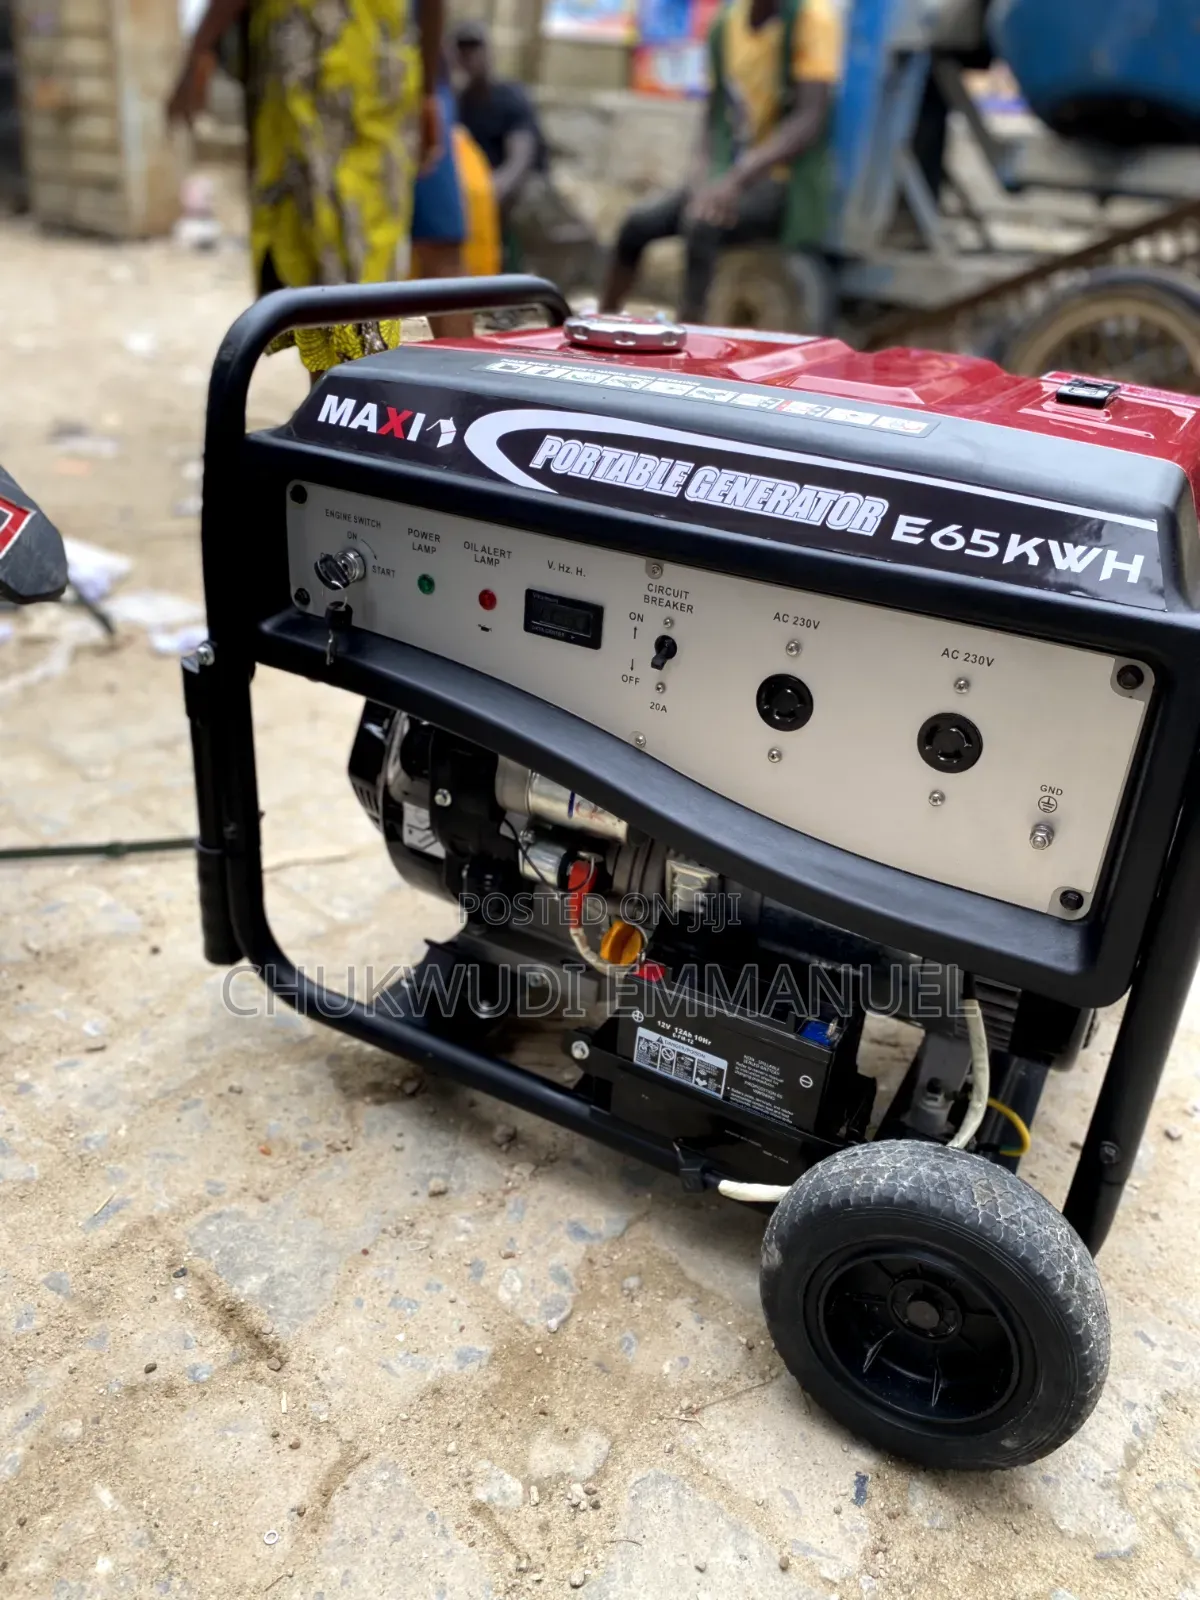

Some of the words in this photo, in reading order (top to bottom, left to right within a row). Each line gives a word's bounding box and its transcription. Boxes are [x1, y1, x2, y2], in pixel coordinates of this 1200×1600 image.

[317, 394, 426, 441] MAXI
[529, 435, 693, 498] PORTABLE
[684, 466, 889, 537] GENERATOR
[325, 509, 353, 523] ENGINE
[353, 515, 382, 529] SWITCH
[347, 531, 358, 541] ON
[407, 528, 441, 543] POWER
[412, 542, 437, 554] LAMP
[463, 540, 479, 552] OIL
[480, 544, 513, 559] ALERT
[891, 515, 1145, 584] E65KWH
[474, 553, 500, 567] LAMP
[372, 565, 396, 577] START
[647, 583, 690, 600] CIRCUIT
[643, 594, 694, 614] BREAKER
[629, 611, 644, 623] ON
[772, 611, 790, 624] AC
[793, 615, 821, 630] 230V
[940, 647, 959, 660] AC
[962, 652, 995, 668] 230V
[621, 674, 640, 686] OFF
[650, 702, 668, 713] 20A
[1040, 784, 1063, 796] GND
[657, 1020, 671, 1030] 12V
[674, 1027, 693, 1038] 12Ah
[694, 1034, 712, 1046] 10Hr
